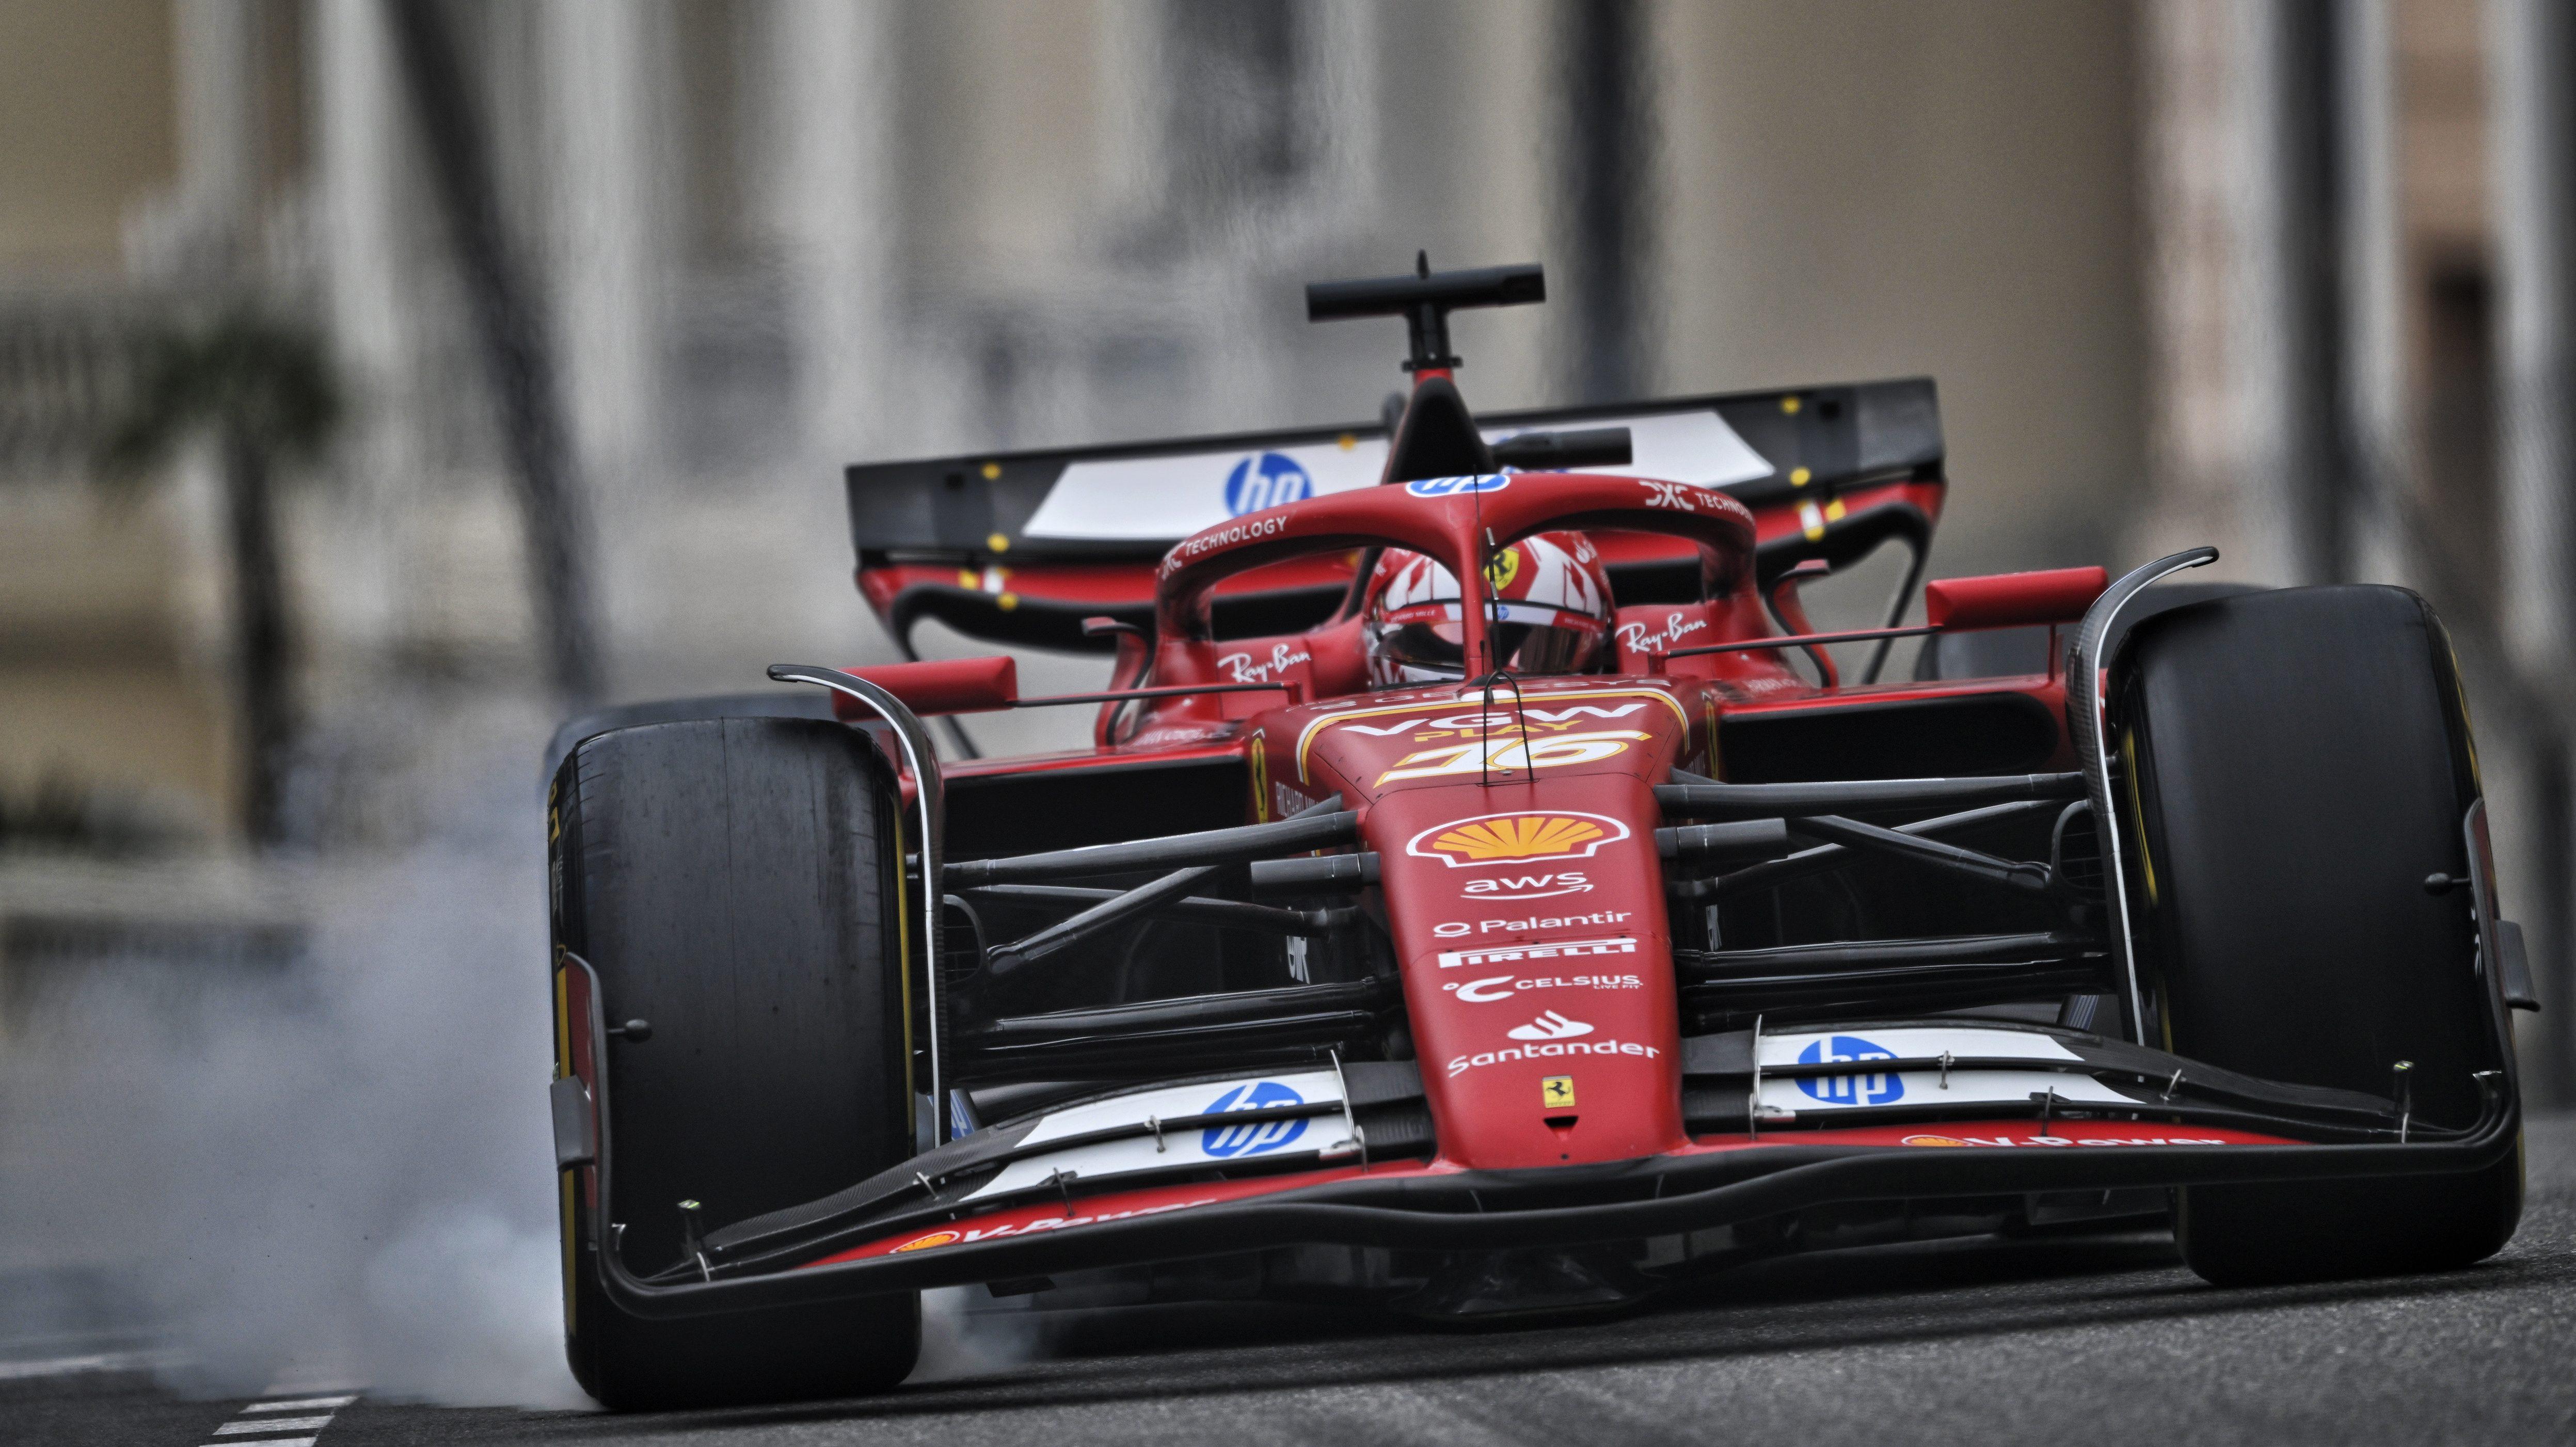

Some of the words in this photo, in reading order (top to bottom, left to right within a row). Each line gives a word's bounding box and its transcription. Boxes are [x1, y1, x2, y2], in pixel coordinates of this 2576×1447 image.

[1235, 452, 1307, 516] hp
[1639, 481, 1695, 511] DXC
[1185, 516, 1287, 556] TECHNOLOGY
[1615, 612, 1708, 654] Ray-Ban
[1217, 643, 1312, 683] Ray-Ban
[1375, 679, 1672, 703] GEESYS
[1340, 703, 1648, 736] VGW
[1414, 720, 1584, 742] PLAY
[1373, 730, 1652, 789] 16
[1464, 872, 1588, 893] aws
[1480, 911, 1632, 933] Palantir
[1438, 938, 1637, 968] PIRELLI
[1515, 975, 1642, 990] CELSIUS
[1447, 1039, 1660, 1077] Santander
[1817, 1036, 1890, 1105] hp
[1208, 1083, 1301, 1156] hp
